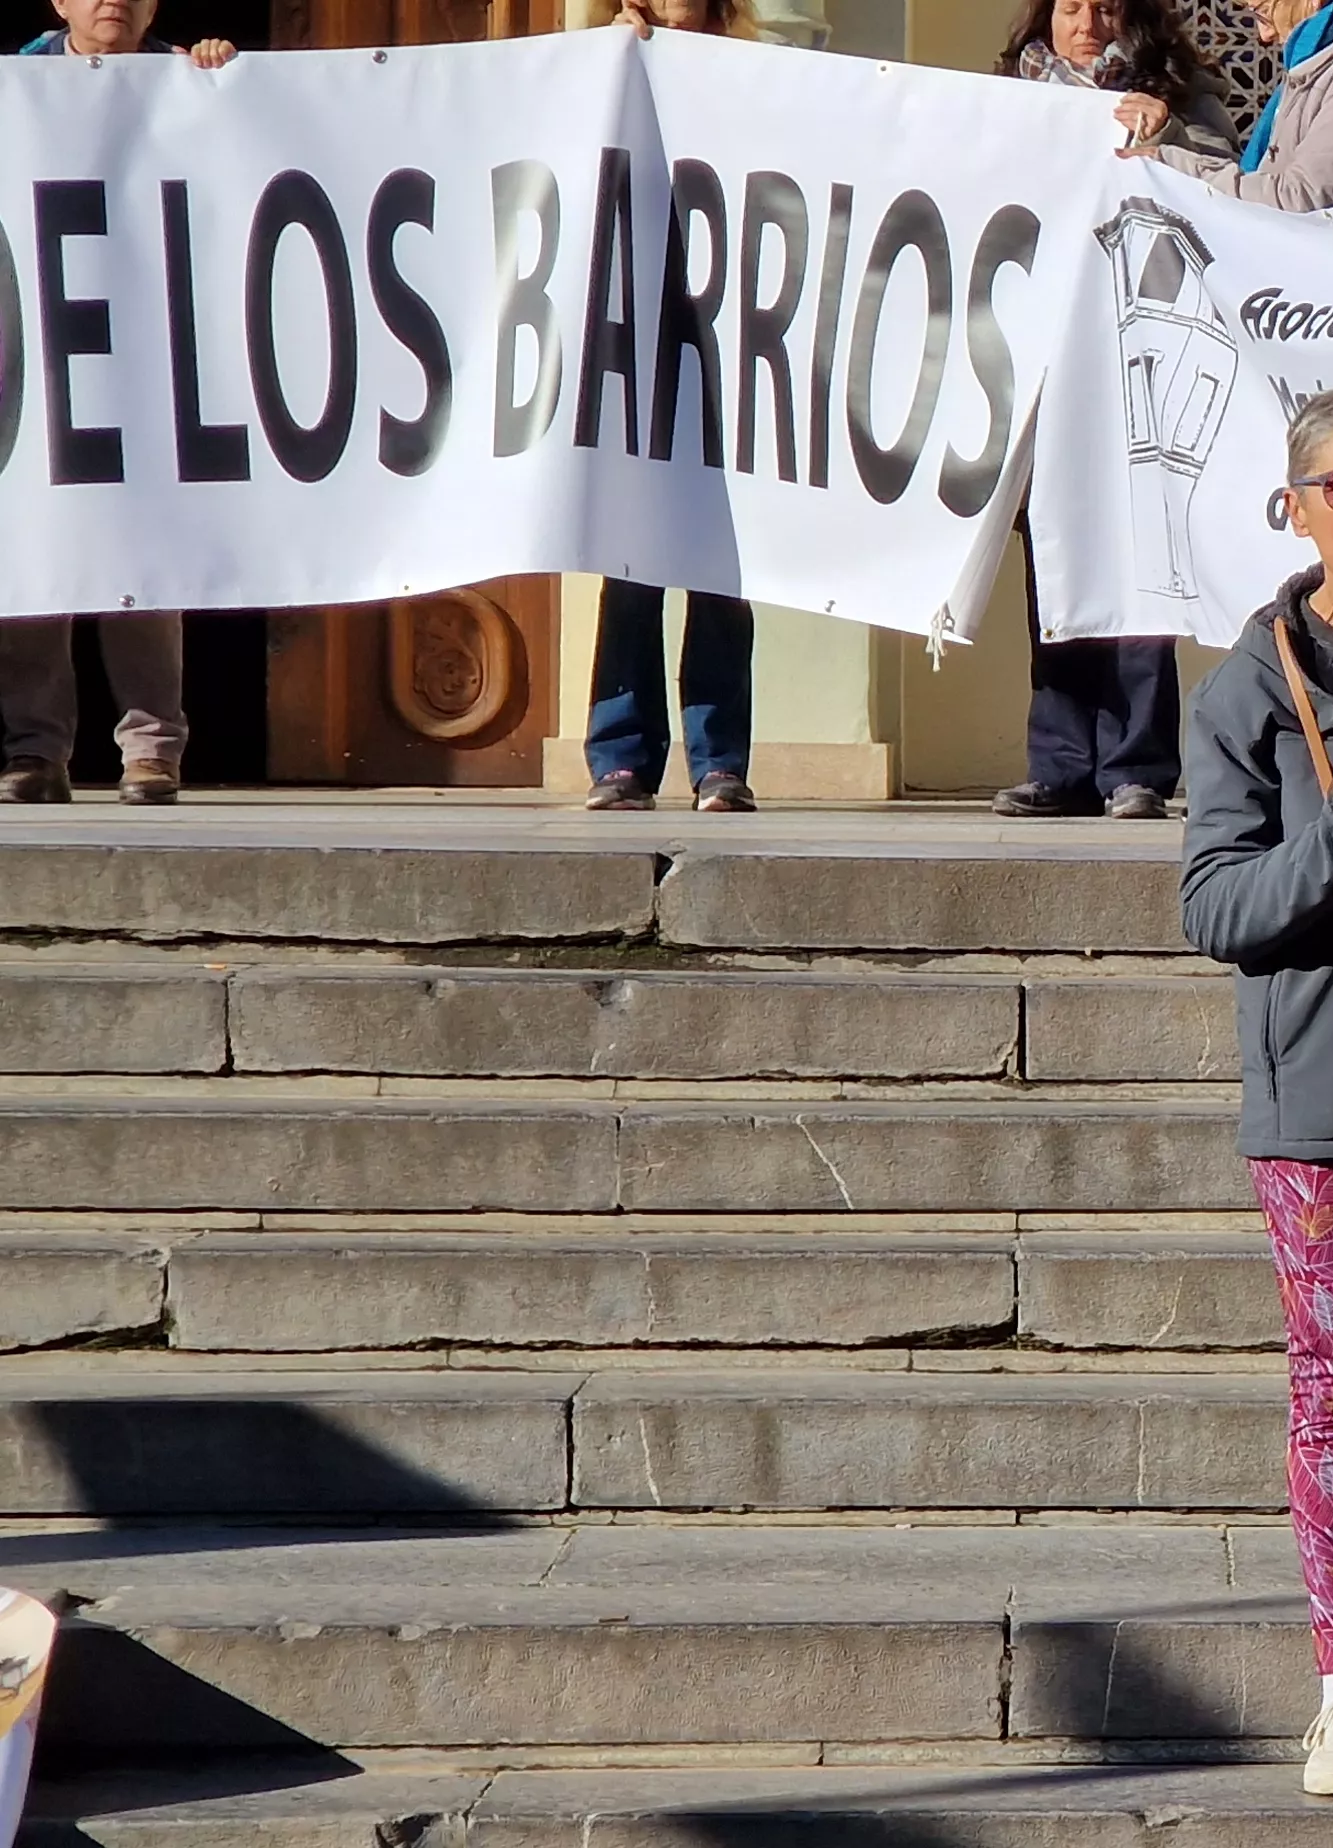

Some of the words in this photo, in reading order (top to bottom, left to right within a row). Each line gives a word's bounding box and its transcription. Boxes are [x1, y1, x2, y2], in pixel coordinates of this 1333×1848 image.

[0, 178, 126, 486] E
[160, 167, 453, 484] LOS
[490, 146, 1042, 519] BARRIOS
